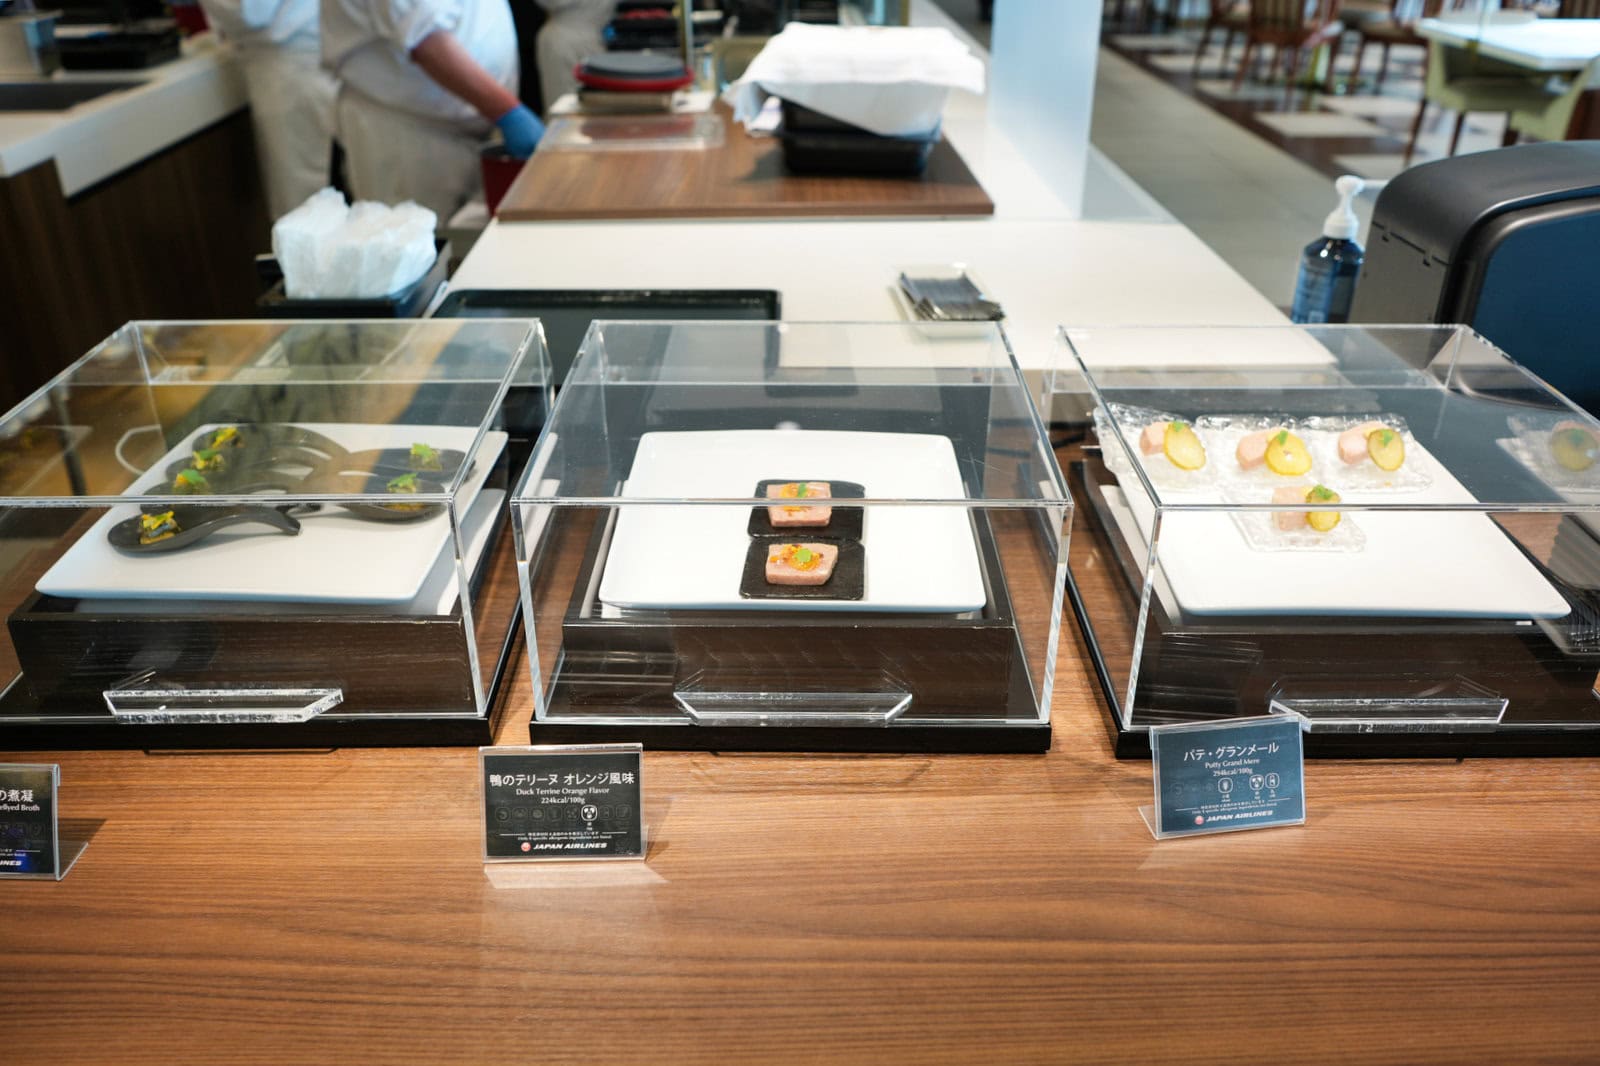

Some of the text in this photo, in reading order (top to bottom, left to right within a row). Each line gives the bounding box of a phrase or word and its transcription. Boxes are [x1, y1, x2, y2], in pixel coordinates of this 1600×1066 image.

[1184, 742, 1280, 761] パテ・グランメール
[1223, 759, 1242, 767] Grand
[489, 772, 635, 787] 鴨のテリーヌ オレンジ風味
[516, 788, 534, 796] Duck
[562, 788, 588, 796] Orange
[541, 797, 586, 805] 224kcal/100g
[21, 804, 41, 812] Broth
[1206, 810, 1273, 822] JAPAN AIRLINES
